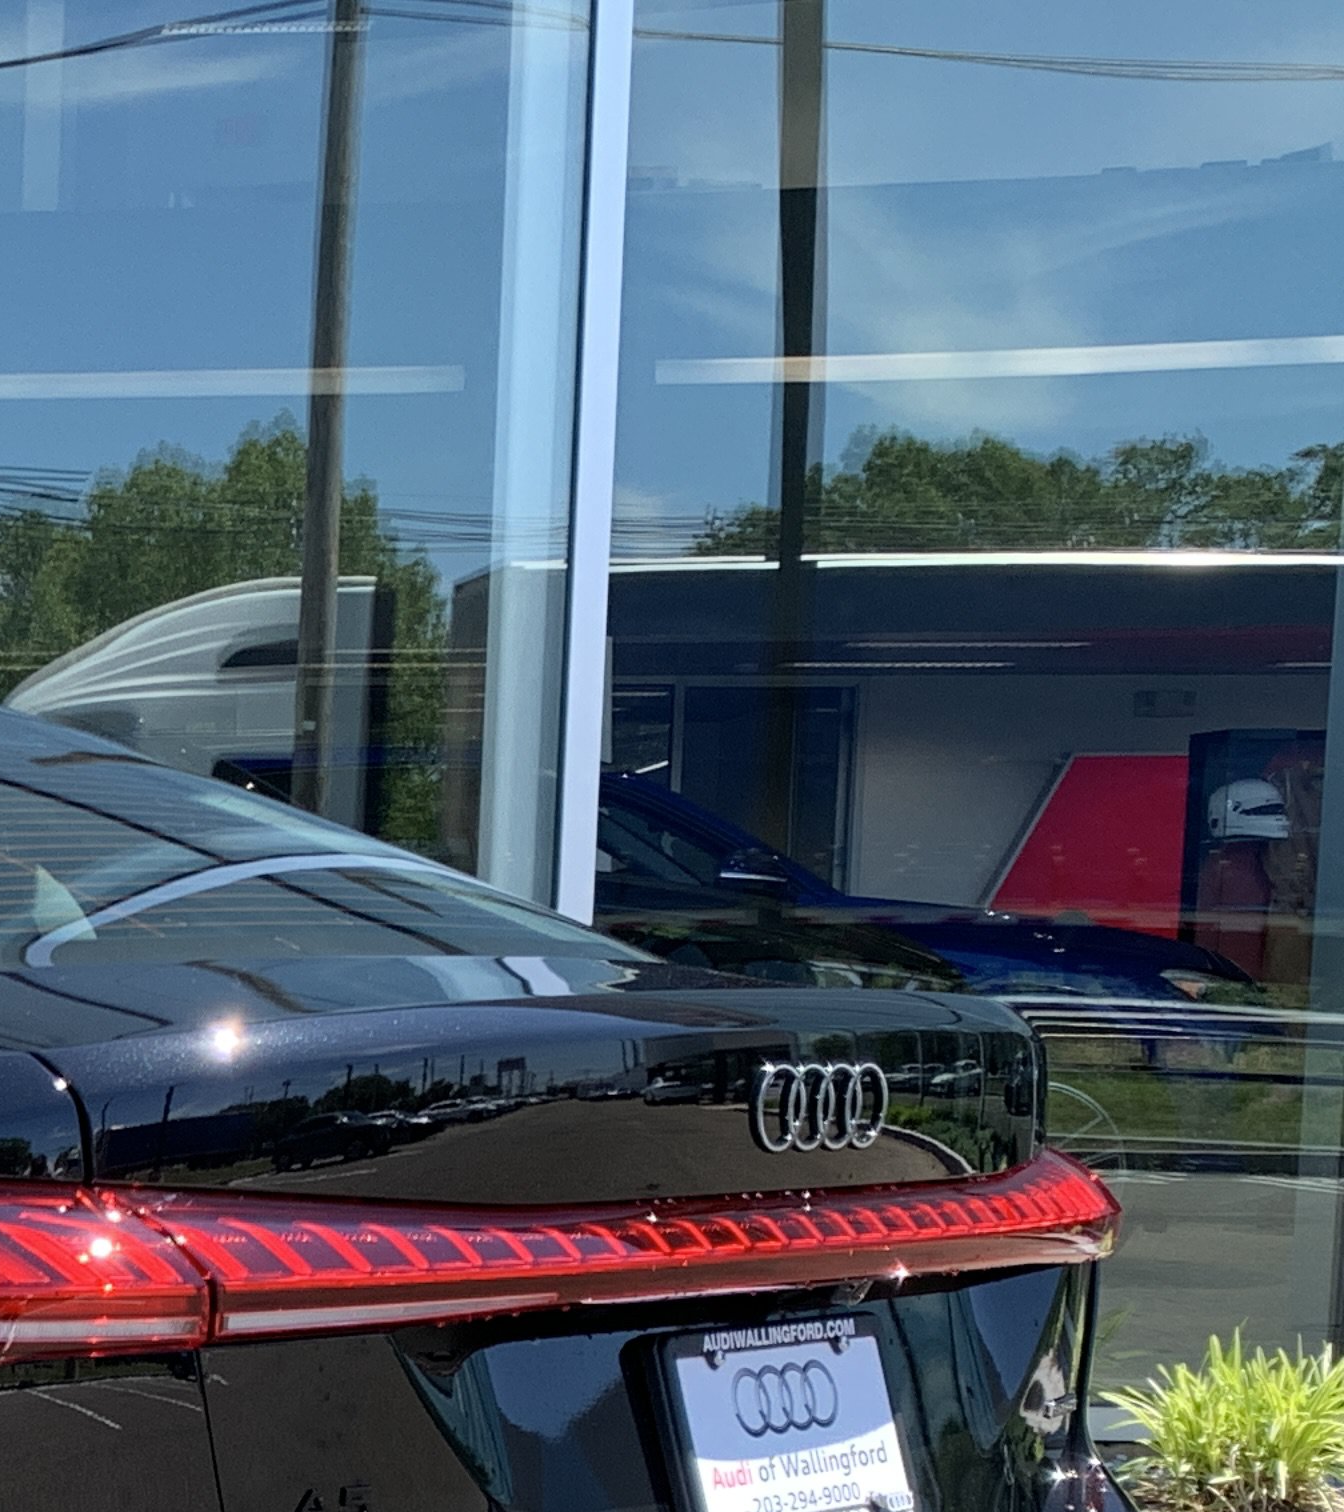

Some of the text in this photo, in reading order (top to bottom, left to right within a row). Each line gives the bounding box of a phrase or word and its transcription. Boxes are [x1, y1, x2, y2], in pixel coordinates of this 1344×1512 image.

[703, 1318, 855, 1352] AUDIWALLINGFORD.COM
[712, 1441, 887, 1490] Audi of Wallingford
